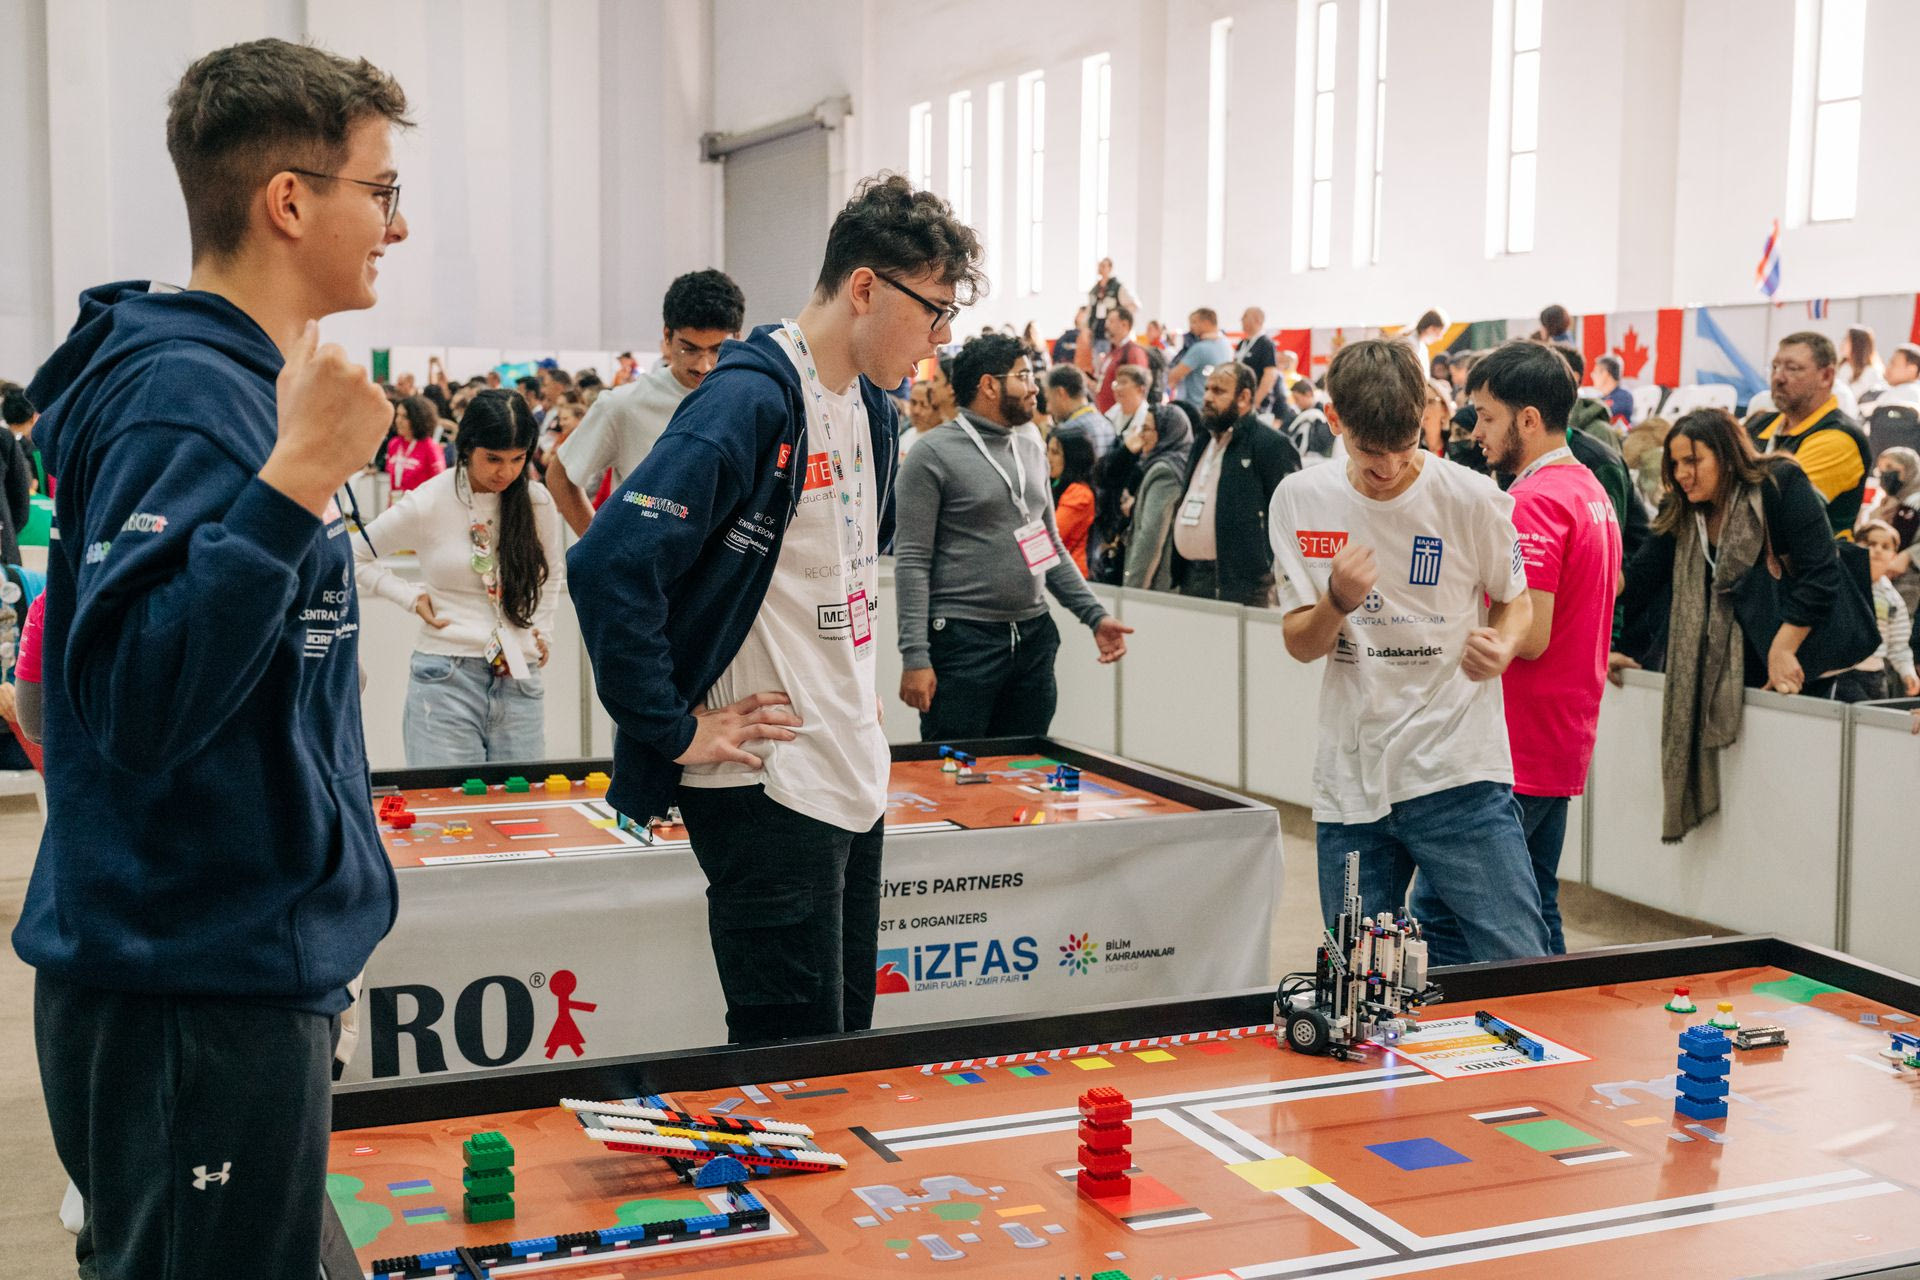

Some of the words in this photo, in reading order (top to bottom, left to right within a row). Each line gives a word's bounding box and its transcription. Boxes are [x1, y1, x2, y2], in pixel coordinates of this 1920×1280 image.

[797, 488, 837, 504] educati
[1299, 536, 1344, 554] STEM
[880, 880, 928, 898] İYE'S
[933, 873, 1024, 894] PARTNERS
[911, 912, 988, 929] ORGANIZERS
[1105, 946, 1175, 962] KAHRAMANLARI
[332, 975, 535, 1081] RO
[1420, 1020, 1469, 1031] aramc
